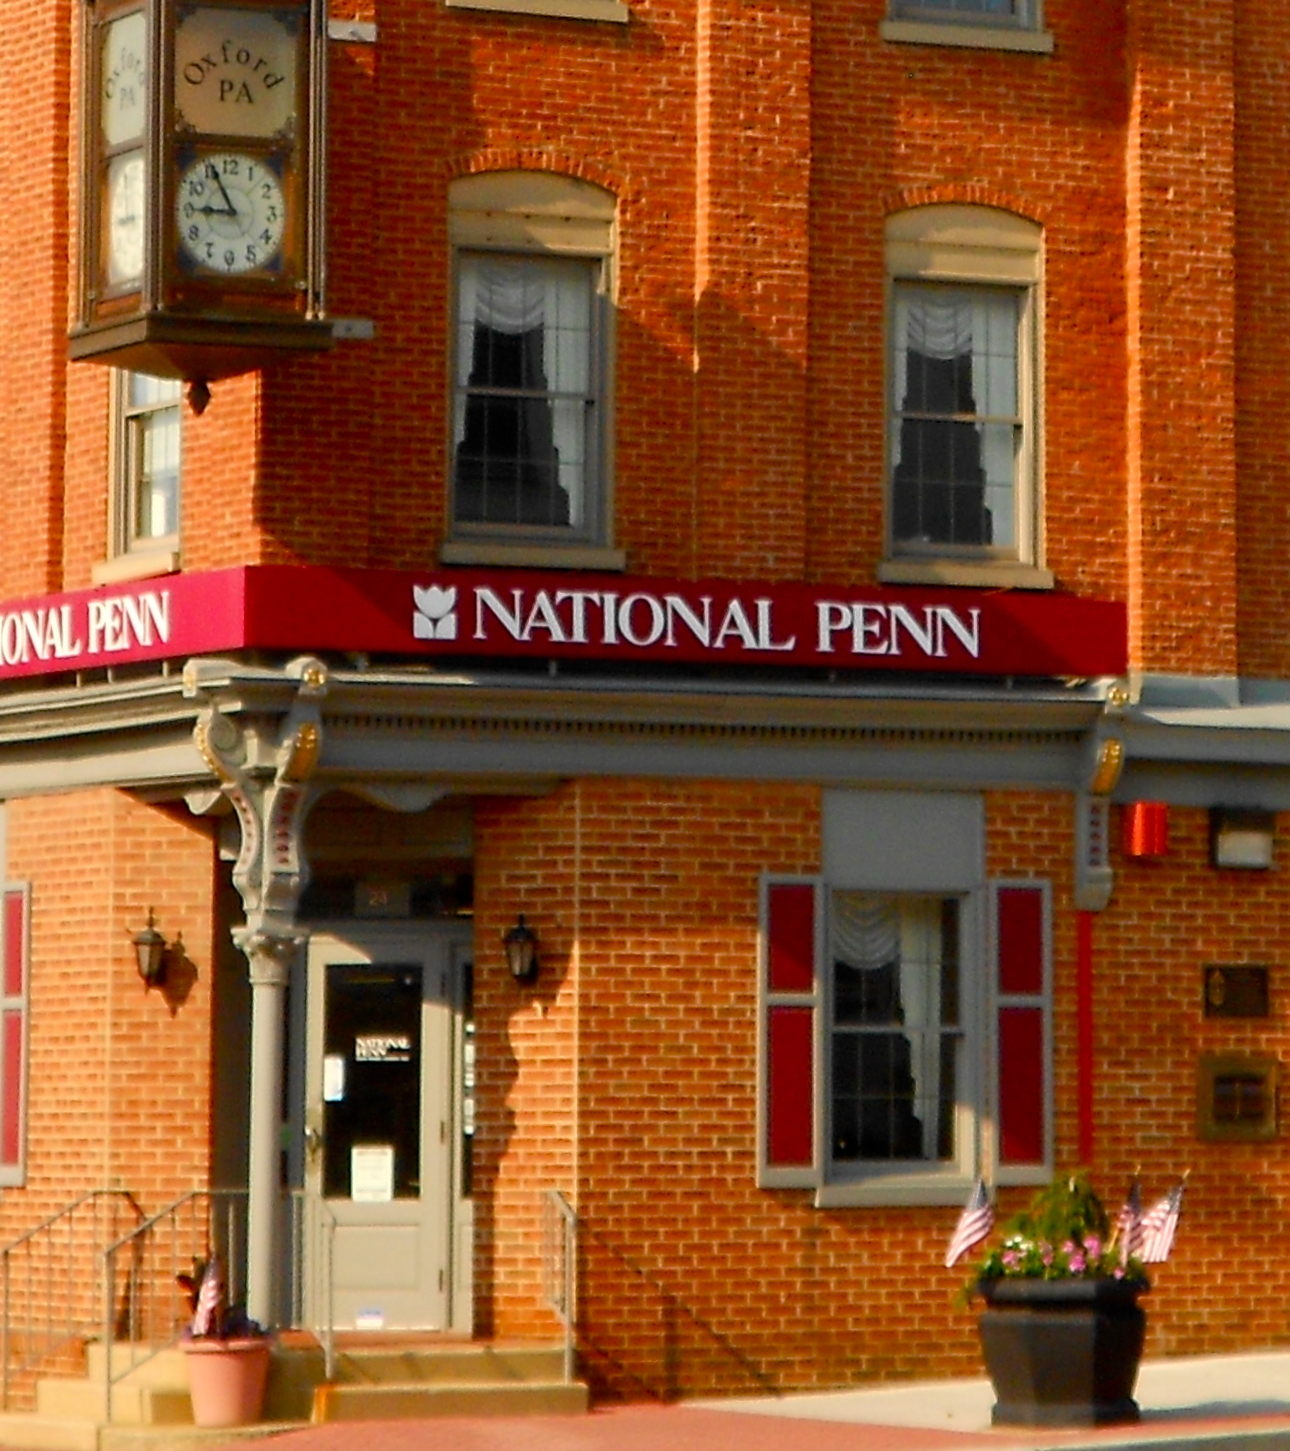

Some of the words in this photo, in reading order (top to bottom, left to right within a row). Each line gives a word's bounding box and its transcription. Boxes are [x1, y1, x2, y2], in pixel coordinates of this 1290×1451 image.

[183, 39, 285, 89] Oxford
[218, 80, 254, 104] PA
[223, 159, 239, 176] 12
[262, 183, 272, 200] 2
[266, 206, 278, 224] 3
[188, 224, 200, 242] 8
[259, 228, 273, 246] 4
[245, 244, 257, 264] 5
[87, 591, 170, 654] PENN
[473, 587, 796, 652] NATIONAL
[815, 600, 981, 659] PENN
[355, 1036, 411, 1049] NATIONAL
